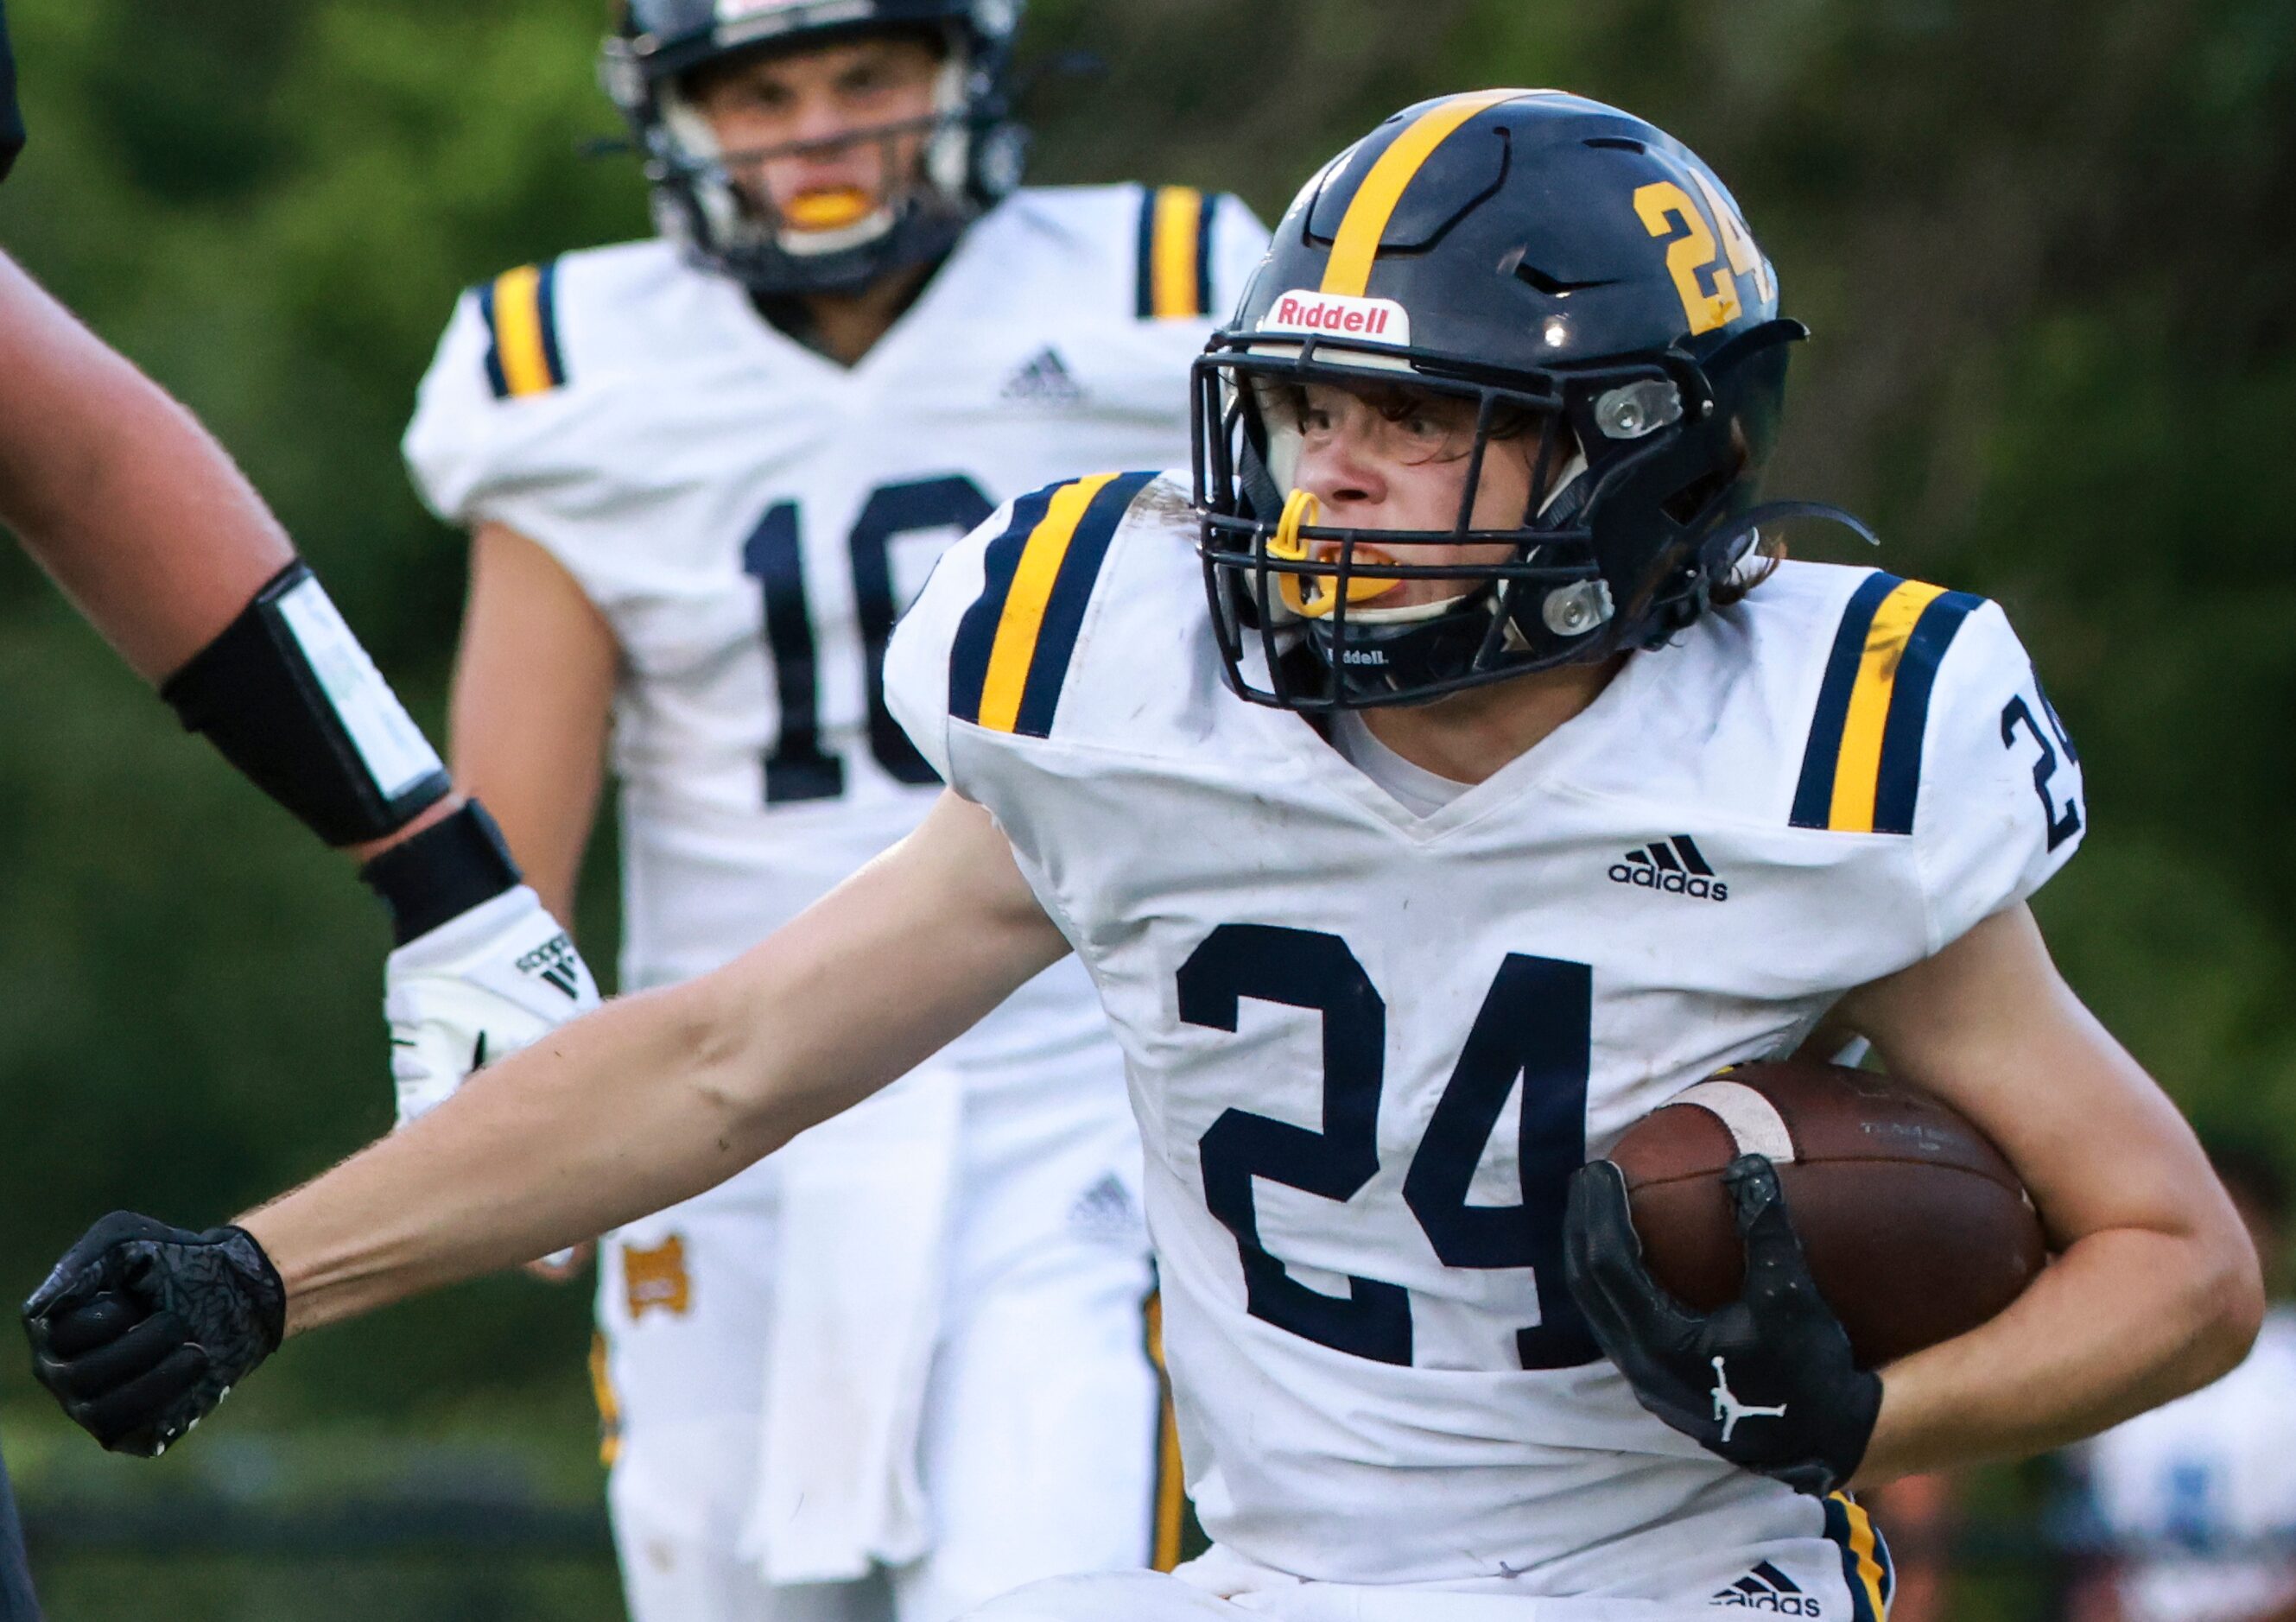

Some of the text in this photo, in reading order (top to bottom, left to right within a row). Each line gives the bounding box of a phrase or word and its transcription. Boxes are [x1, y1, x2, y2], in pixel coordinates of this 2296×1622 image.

[1633, 167, 1774, 336] 24
[1278, 298, 1389, 334] Riddell
[1608, 865, 1728, 902] adidas
[1177, 923, 1603, 1371] 24
